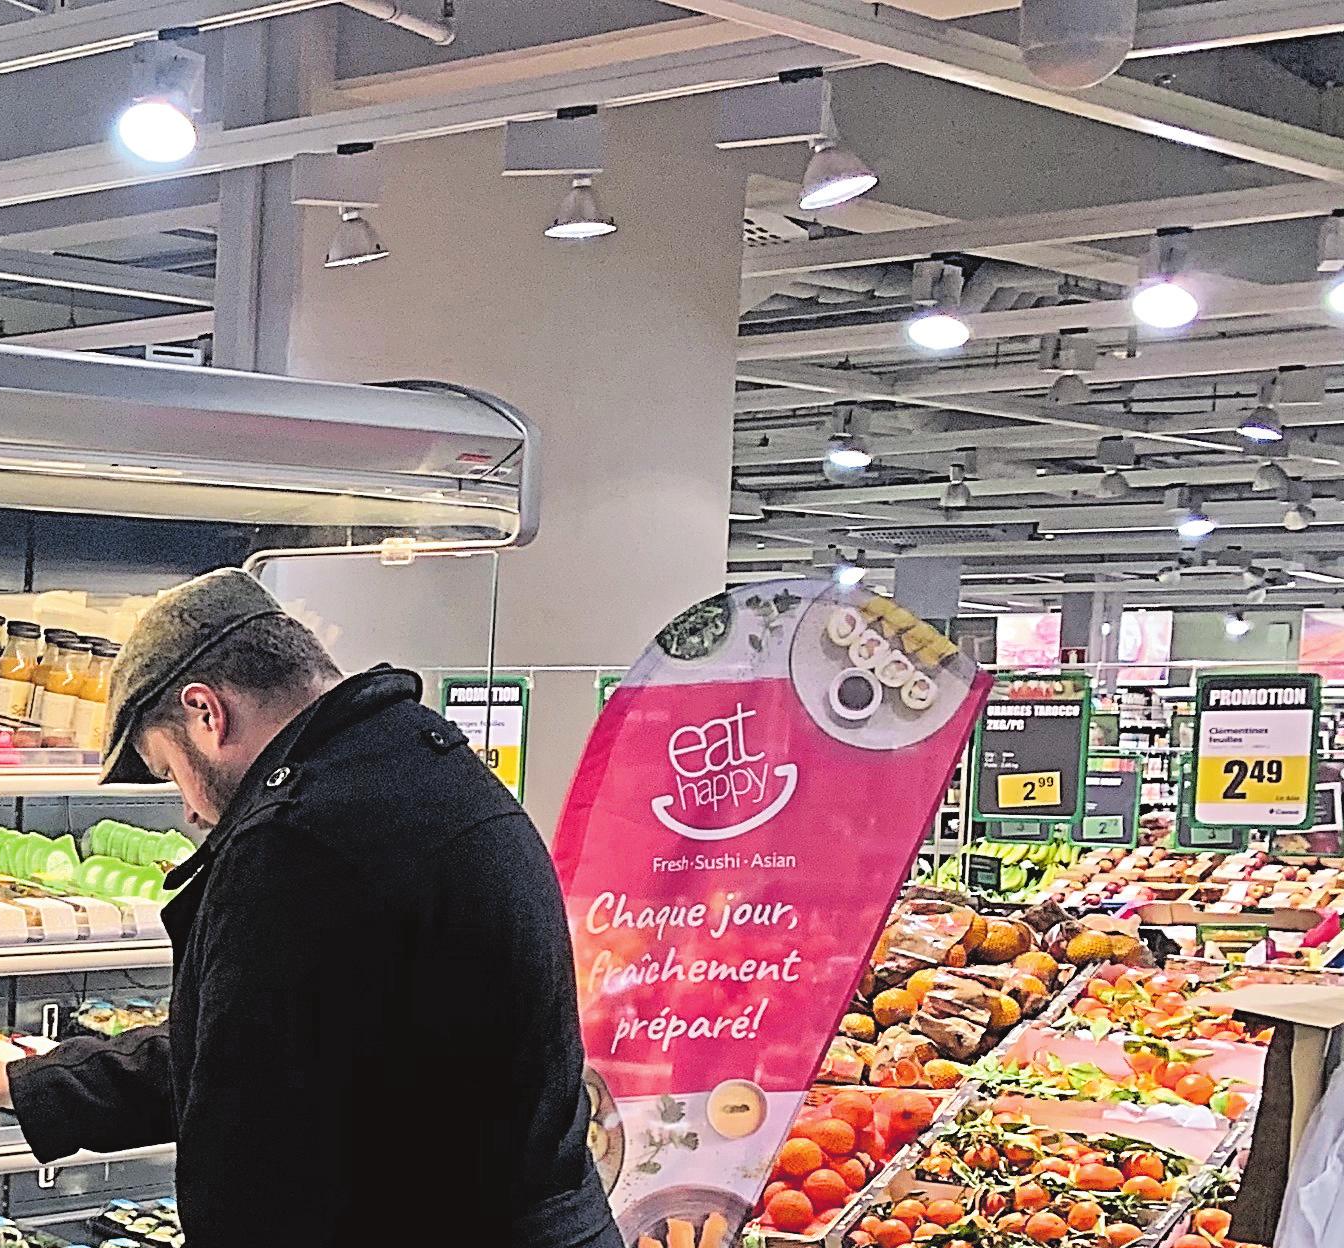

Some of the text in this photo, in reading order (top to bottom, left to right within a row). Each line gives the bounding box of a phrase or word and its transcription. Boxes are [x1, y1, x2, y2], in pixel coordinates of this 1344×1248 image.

[1209, 688, 1307, 706] PROMOTION
[669, 703, 766, 778] eat
[677, 763, 769, 811] happy
[586, 892, 798, 941] Chaque jour,
[588, 947, 802, 993] fraîchement
[610, 997, 769, 1054] préparé!
